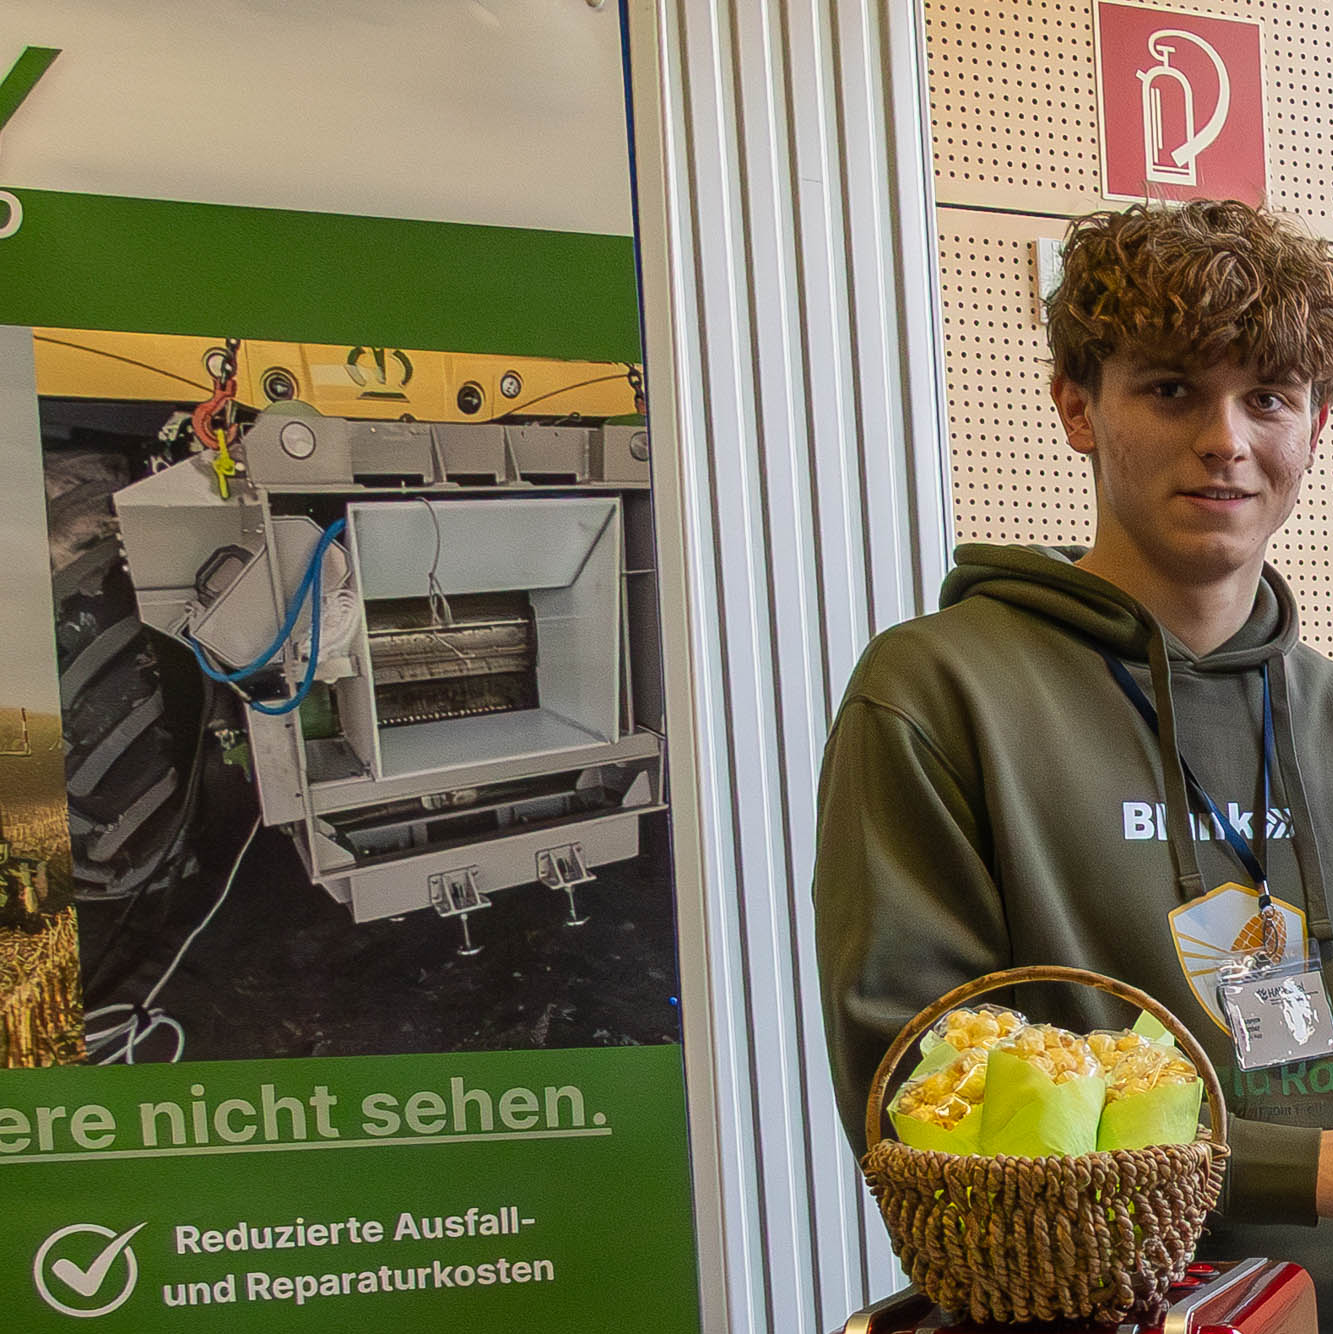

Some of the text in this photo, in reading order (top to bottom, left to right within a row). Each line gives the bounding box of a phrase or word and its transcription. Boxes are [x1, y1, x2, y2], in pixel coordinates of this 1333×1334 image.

[140, 1084, 339, 1147] nicht
[362, 1077, 608, 1135] sehen.
[176, 1207, 536, 1254] Reduzierte Ausfall-
[163, 1256, 555, 1307] und Reparaturkosten
